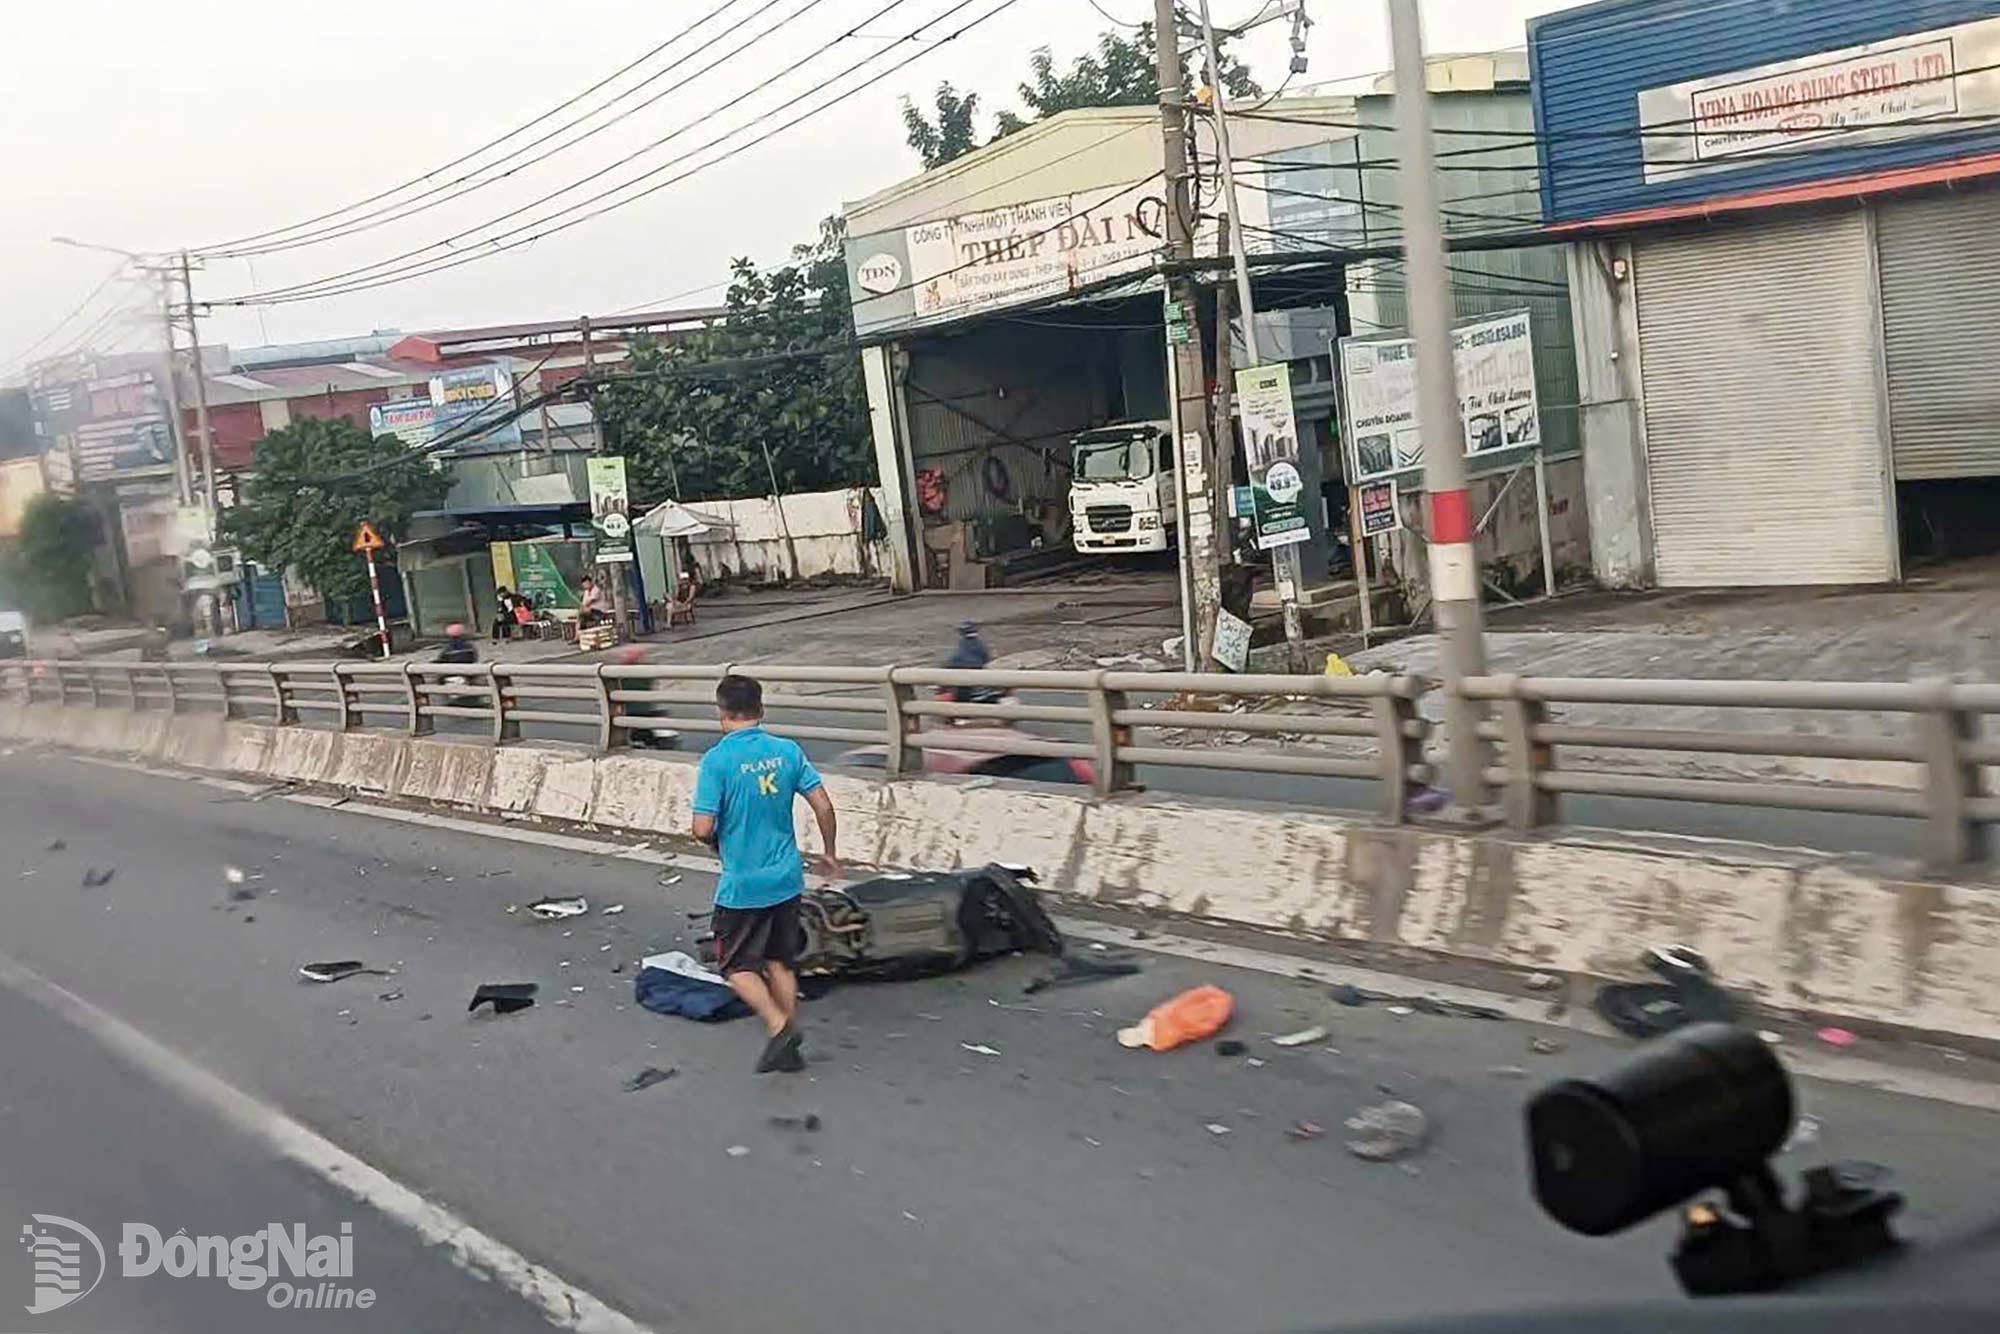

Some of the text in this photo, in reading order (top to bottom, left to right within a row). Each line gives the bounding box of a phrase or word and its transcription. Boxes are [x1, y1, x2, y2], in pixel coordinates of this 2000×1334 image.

[961, 228, 1046, 268] THÉP
[740, 756, 785, 774] PLANT
[758, 772, 778, 796] K
